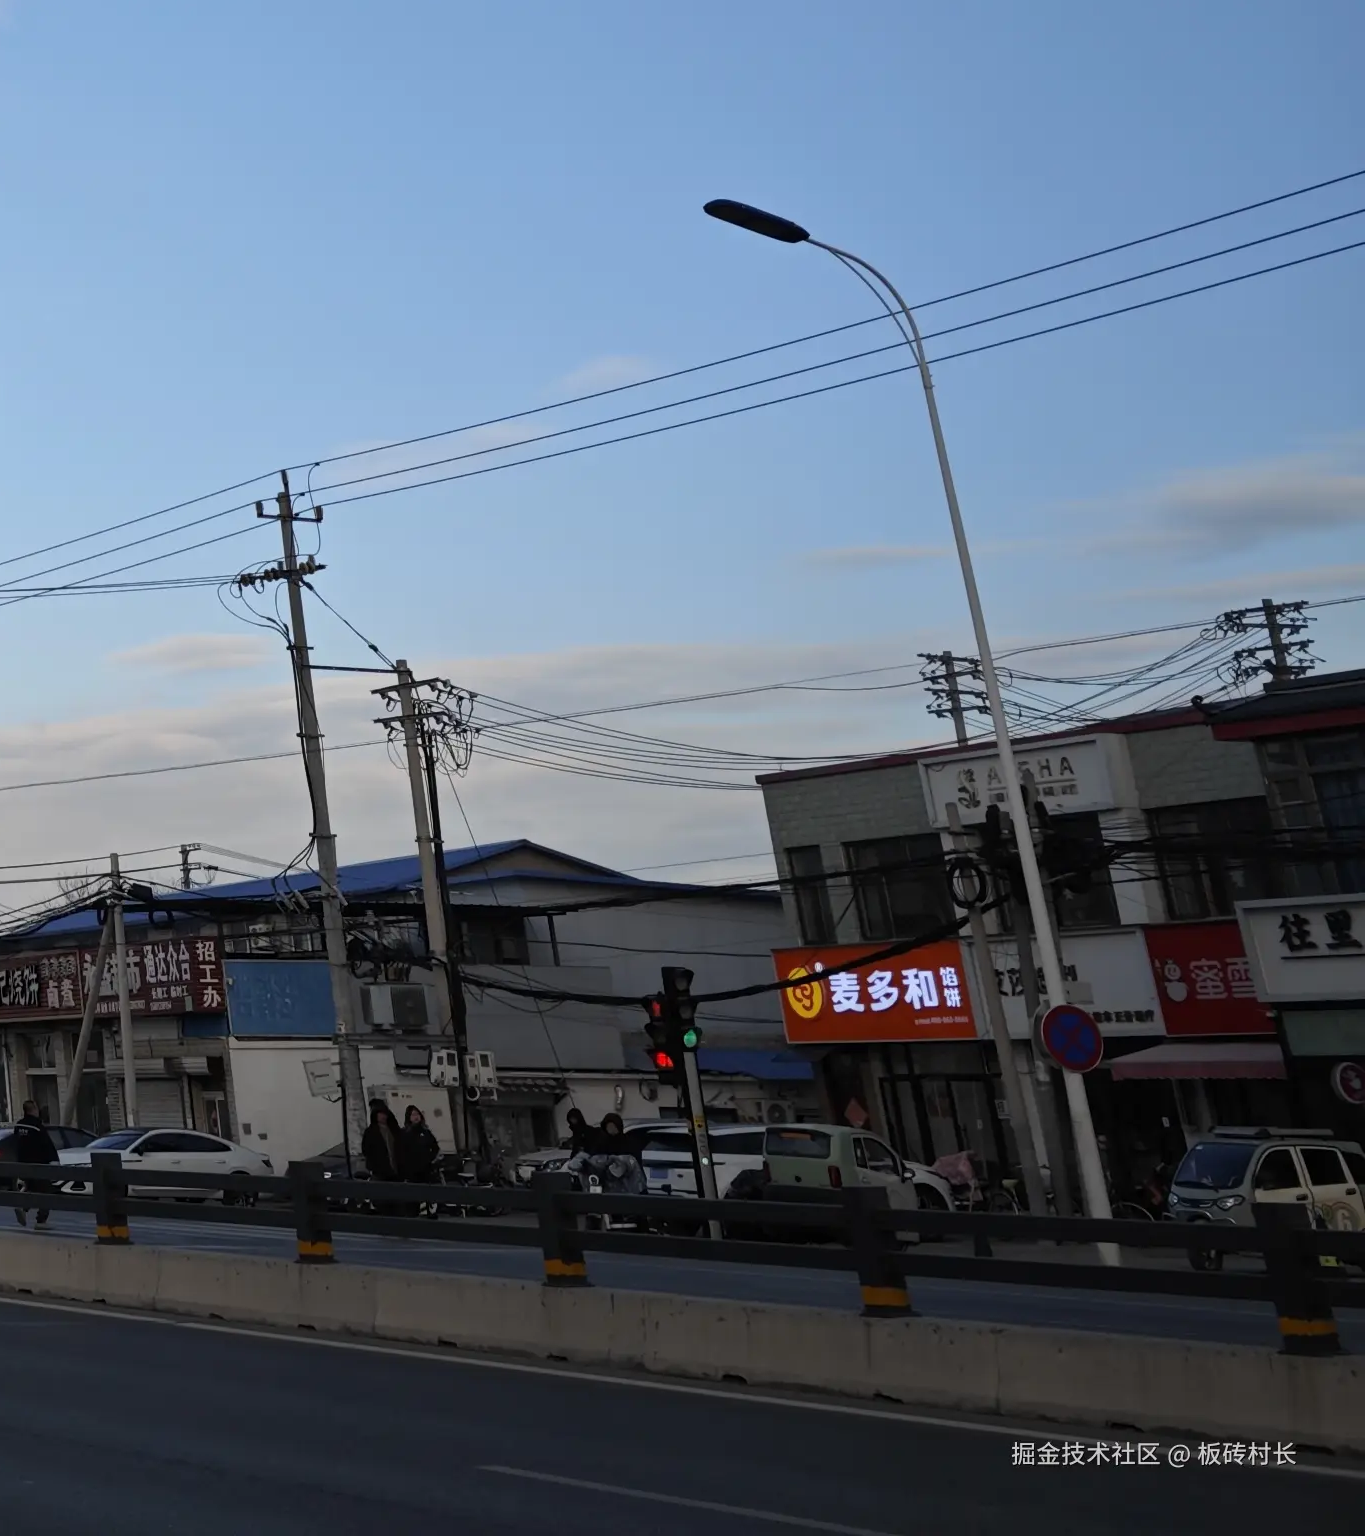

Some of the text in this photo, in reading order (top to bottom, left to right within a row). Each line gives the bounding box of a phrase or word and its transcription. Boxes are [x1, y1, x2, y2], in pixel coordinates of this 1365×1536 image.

[194, 940, 222, 1008] 招工办
[828, 967, 940, 1013] 麦多和
[939, 966, 961, 1008] 馅饼
[1189, 957, 1256, 1000] 蜜雪
